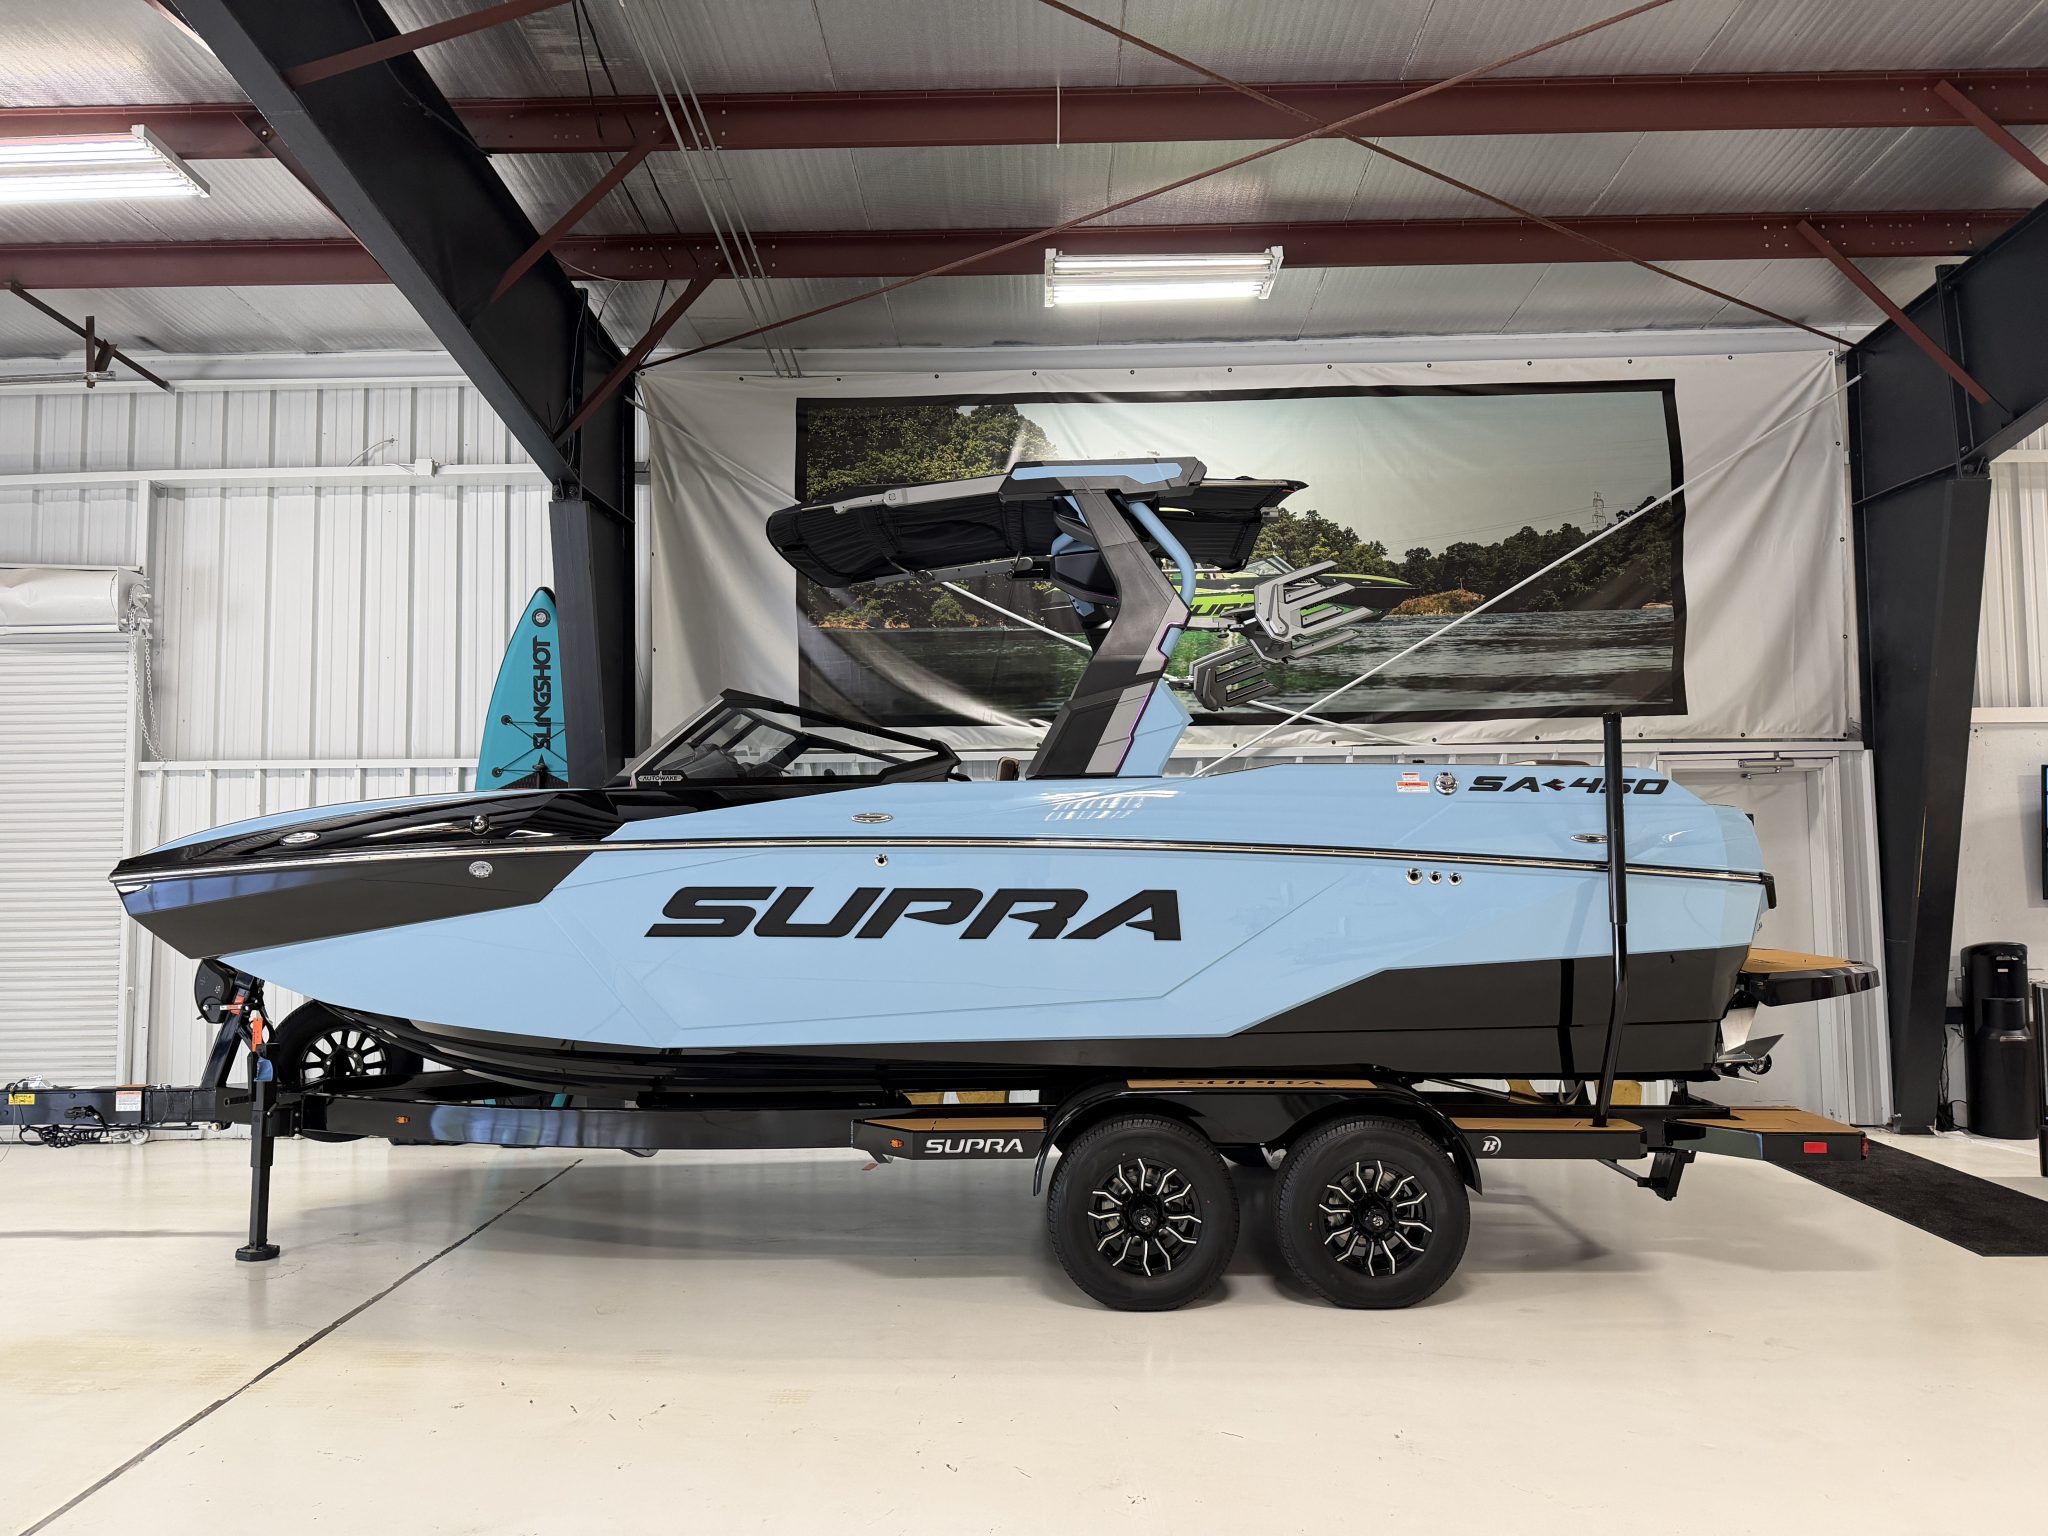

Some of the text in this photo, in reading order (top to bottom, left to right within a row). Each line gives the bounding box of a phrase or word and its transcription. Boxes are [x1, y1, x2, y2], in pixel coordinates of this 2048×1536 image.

[533, 635, 551, 750] SLINGSHOT
[644, 886, 1182, 941] SUPRA
[924, 1138, 1024, 1154] SUPRA
